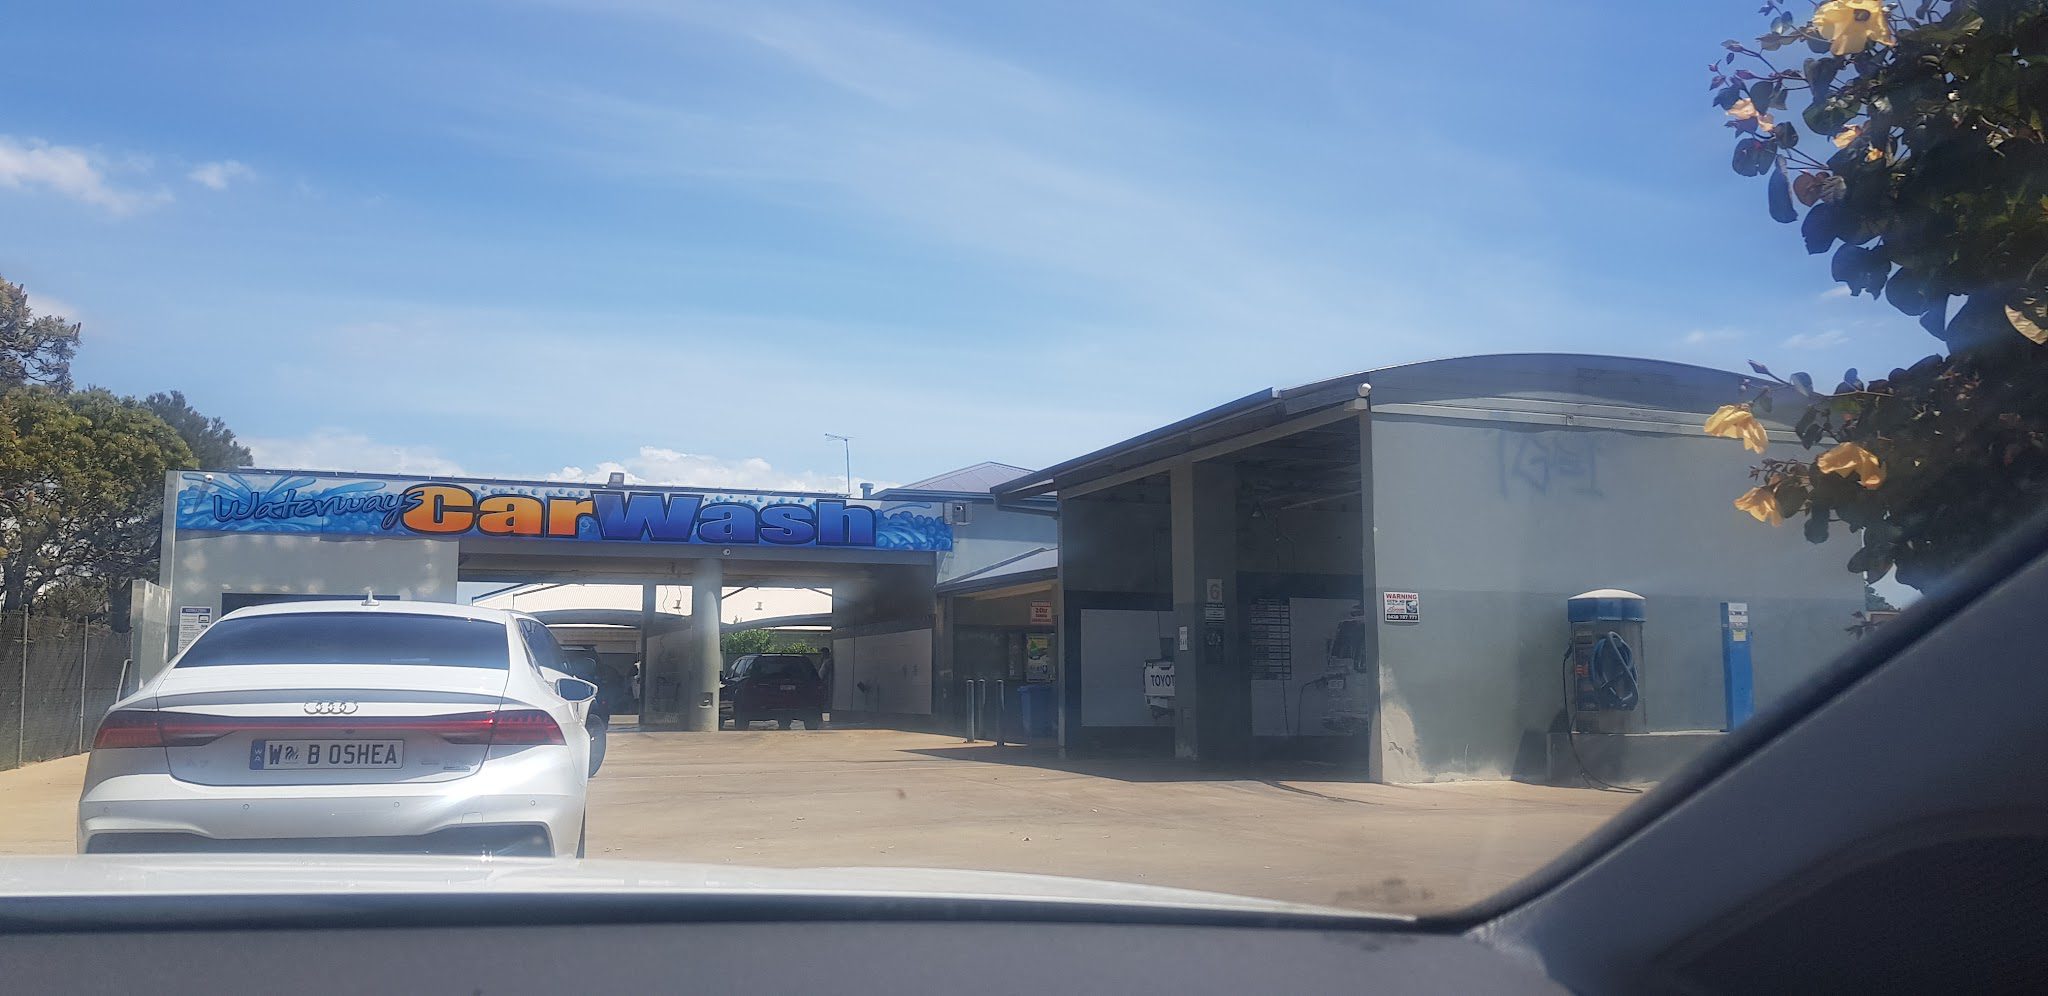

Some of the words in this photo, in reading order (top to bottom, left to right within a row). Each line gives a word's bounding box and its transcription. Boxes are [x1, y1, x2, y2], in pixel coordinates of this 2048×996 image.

[213, 488, 425, 530] Waterways
[1209, 583, 1221, 601] 6
[1150, 674, 1176, 687] TOYOT
[268, 744, 283, 765] W
[307, 744, 321, 765] B
[328, 744, 398, 765] OSHEA
